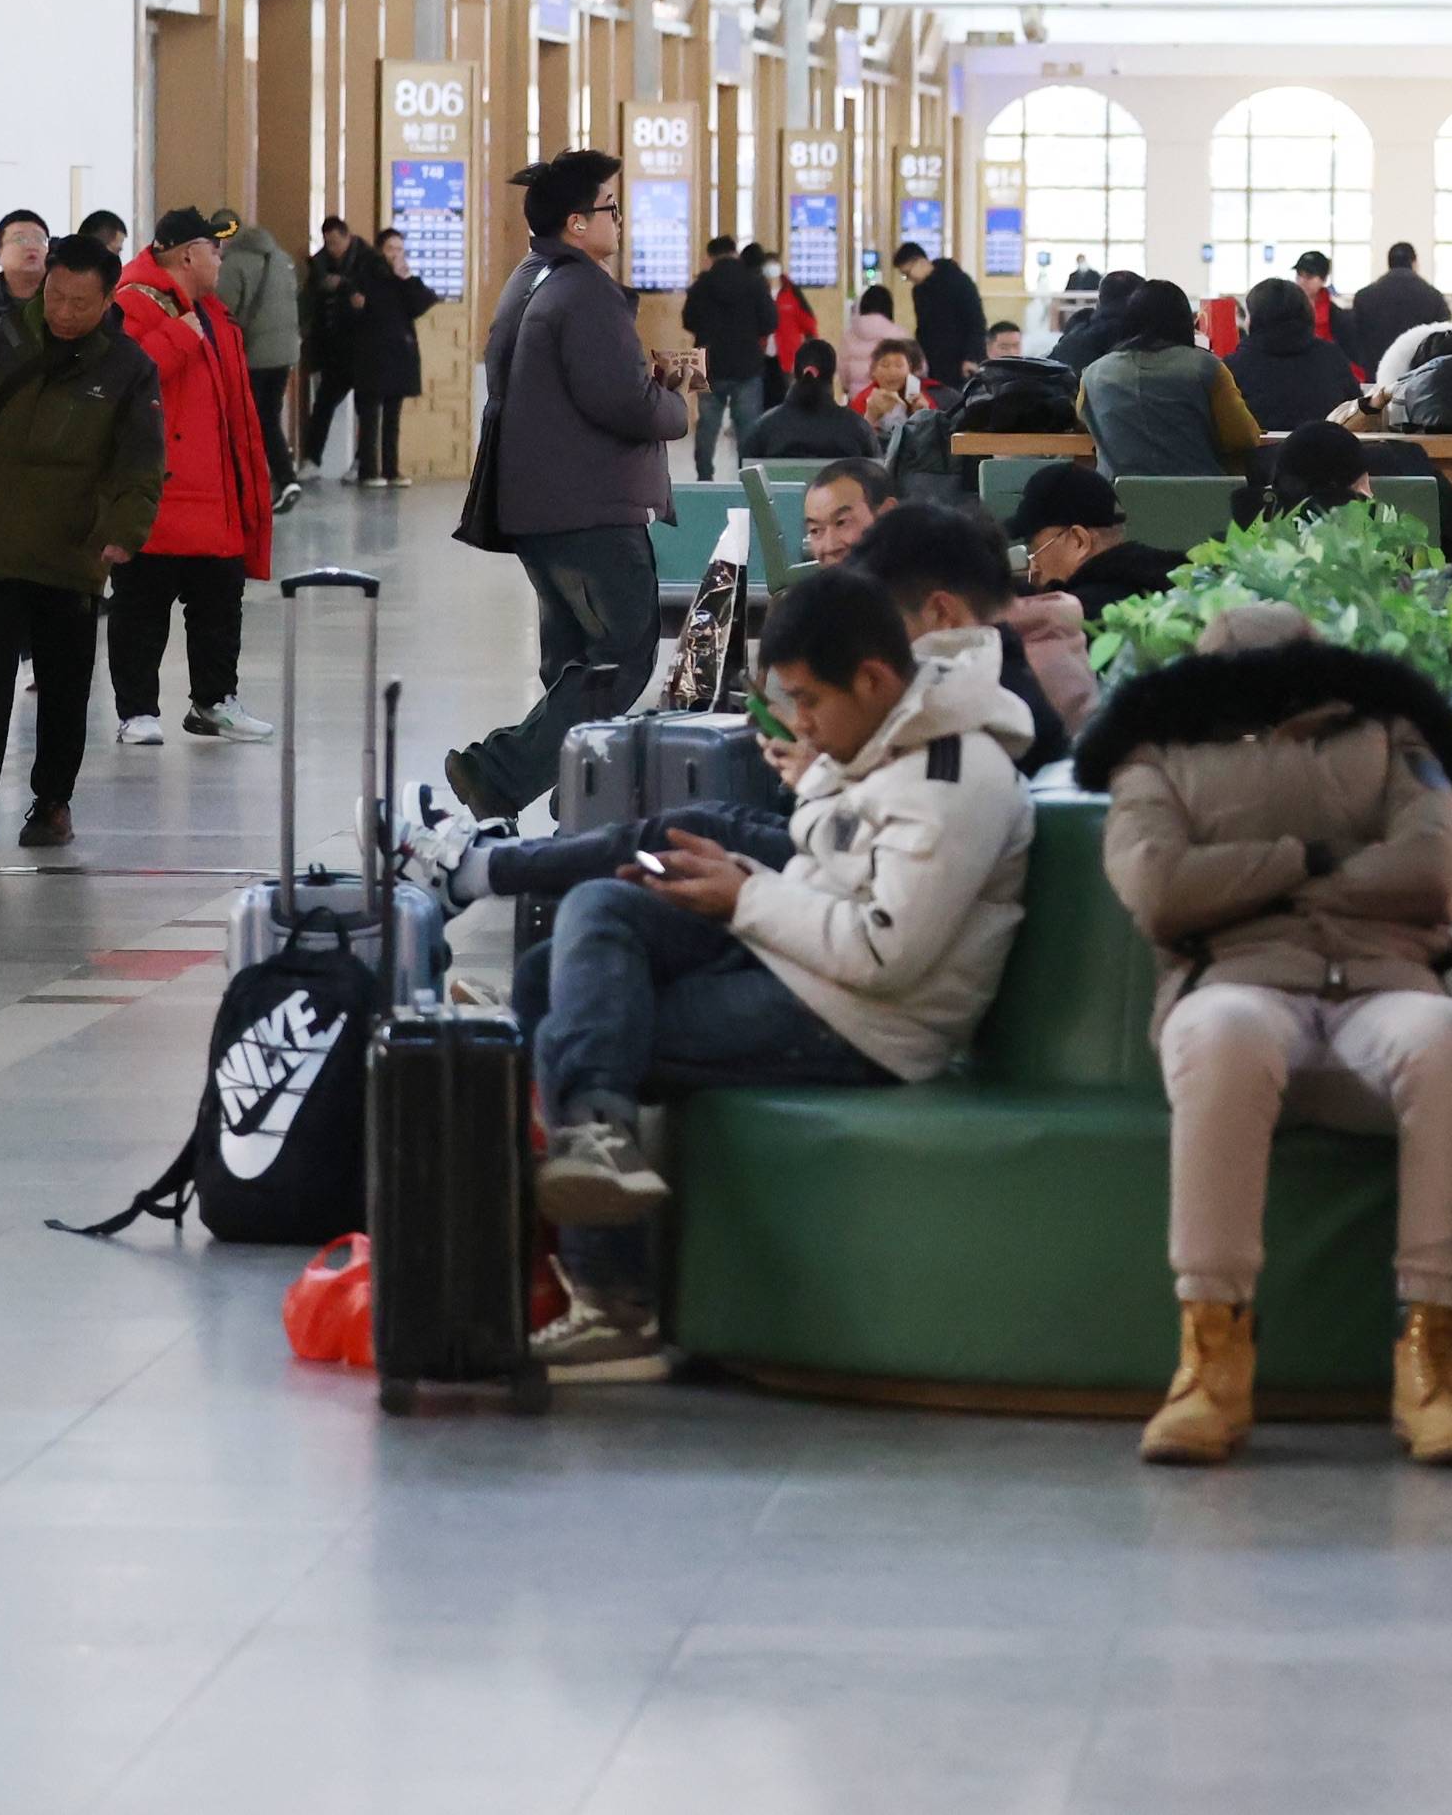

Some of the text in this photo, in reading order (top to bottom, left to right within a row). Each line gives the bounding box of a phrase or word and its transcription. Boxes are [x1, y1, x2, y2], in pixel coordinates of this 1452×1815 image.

[395, 79, 464, 117] 806
[633, 116, 688, 148] 808
[789, 141, 838, 168] 810
[900, 154, 942, 178] 812
[215, 990, 326, 1126] NIKE
